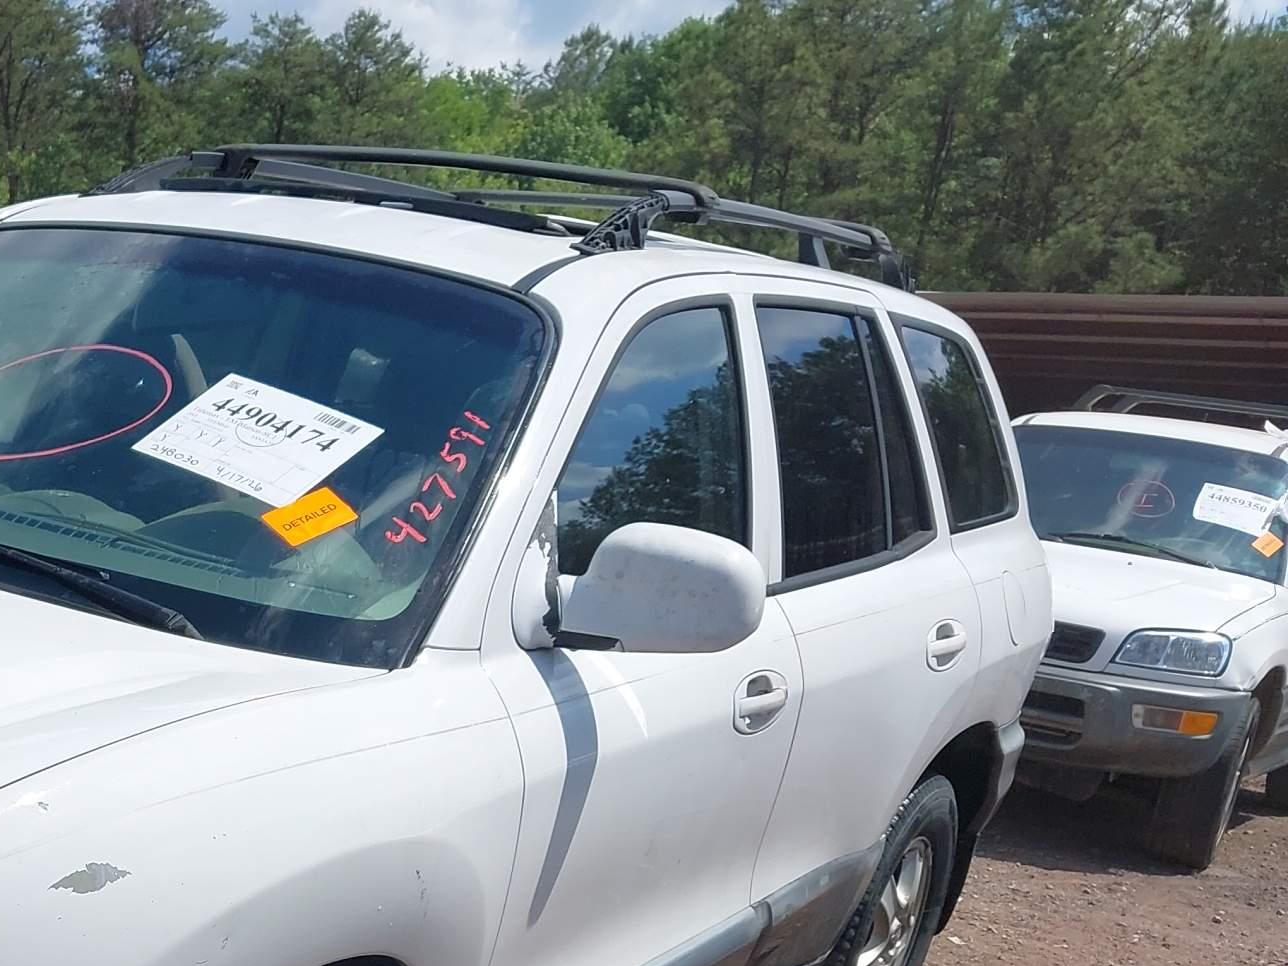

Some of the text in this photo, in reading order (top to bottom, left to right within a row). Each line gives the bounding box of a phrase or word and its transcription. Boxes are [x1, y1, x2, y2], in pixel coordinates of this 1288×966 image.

[212, 398, 340, 452] 44904174
[216, 465, 263, 492] 4/17/26
[384, 411, 491, 543] 427591
[282, 502, 338, 533] DETAILED
[1207, 492, 1268, 514] 44859350
